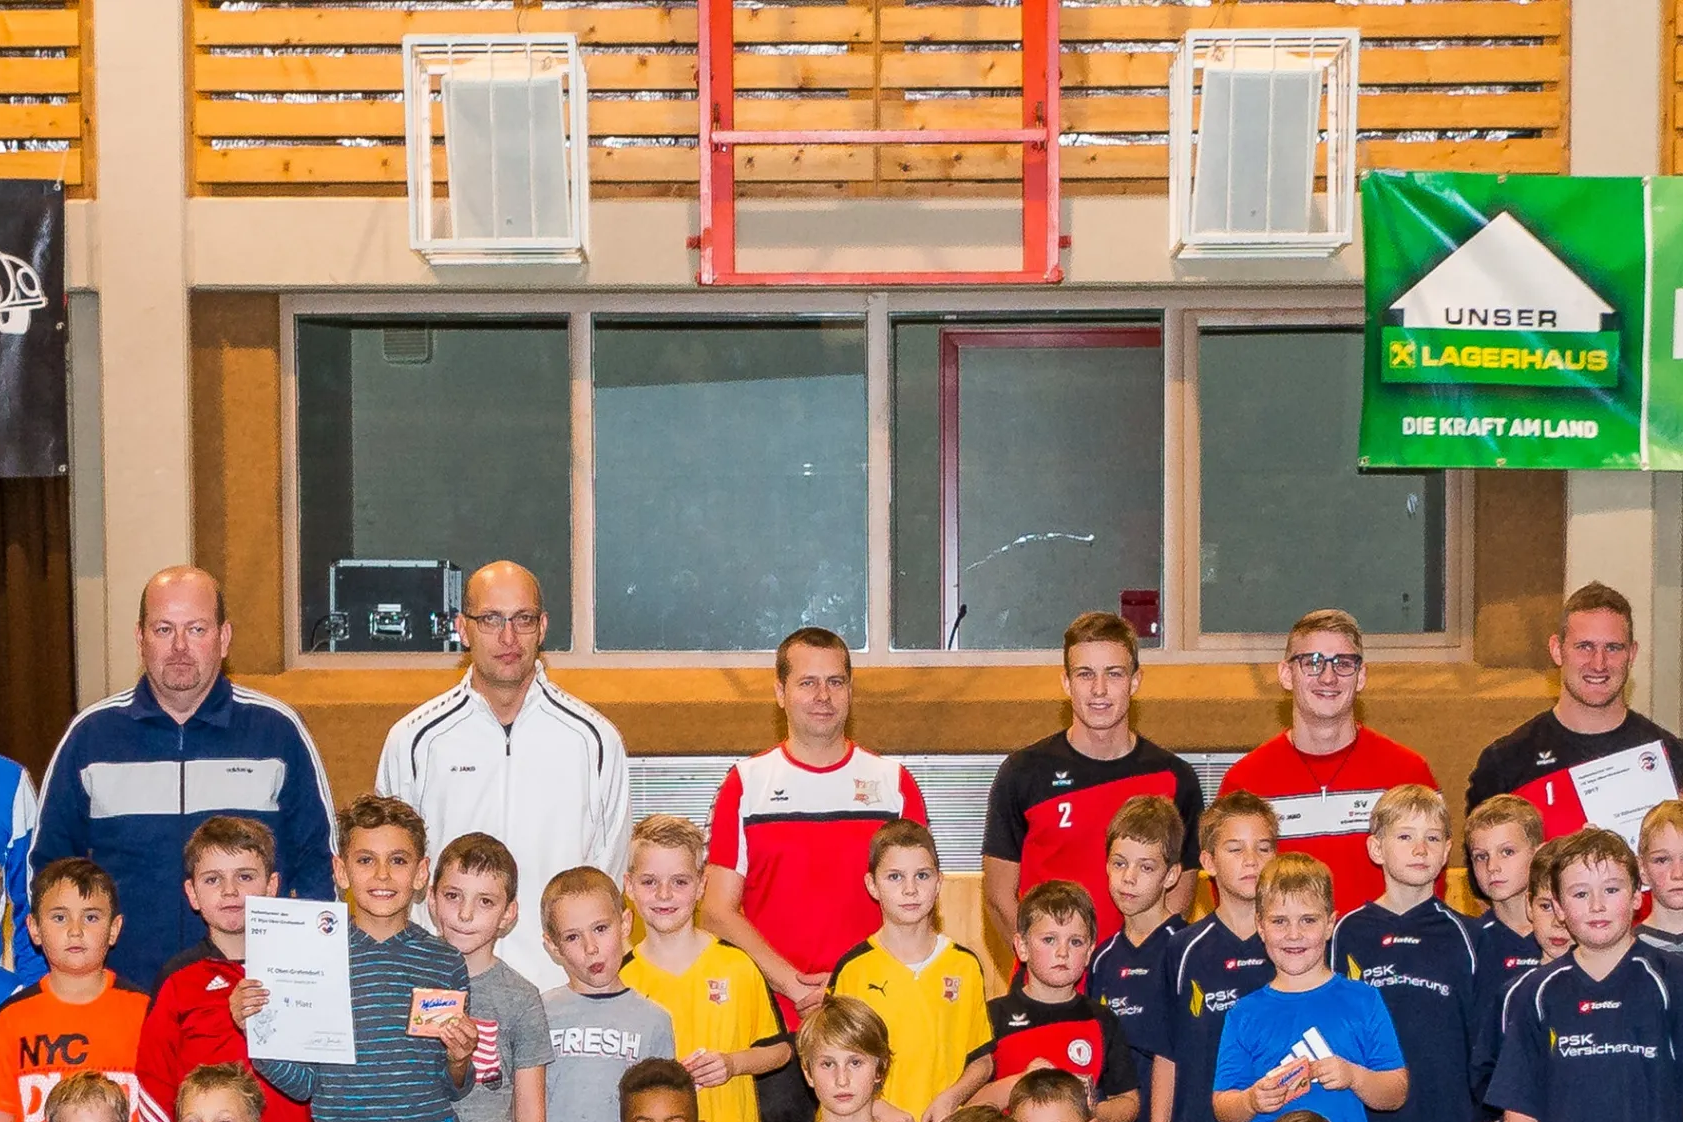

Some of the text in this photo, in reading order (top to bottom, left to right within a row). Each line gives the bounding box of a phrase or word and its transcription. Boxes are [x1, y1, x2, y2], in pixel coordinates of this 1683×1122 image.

[1445, 307, 1558, 328] UNSER
[1421, 345, 1609, 372] LAGERHAUS
[1402, 416, 1599, 439] DIE KRAFT AM LAND
[1058, 802, 1072, 828] 2
[1363, 963, 1395, 979] PSK
[1205, 988, 1238, 1002] PSK
[19, 1033, 90, 1069] NYC
[548, 1027, 642, 1060] FRESH
[1558, 1033, 1594, 1047] PSK
[1559, 1039, 1659, 1058] Versicherung
